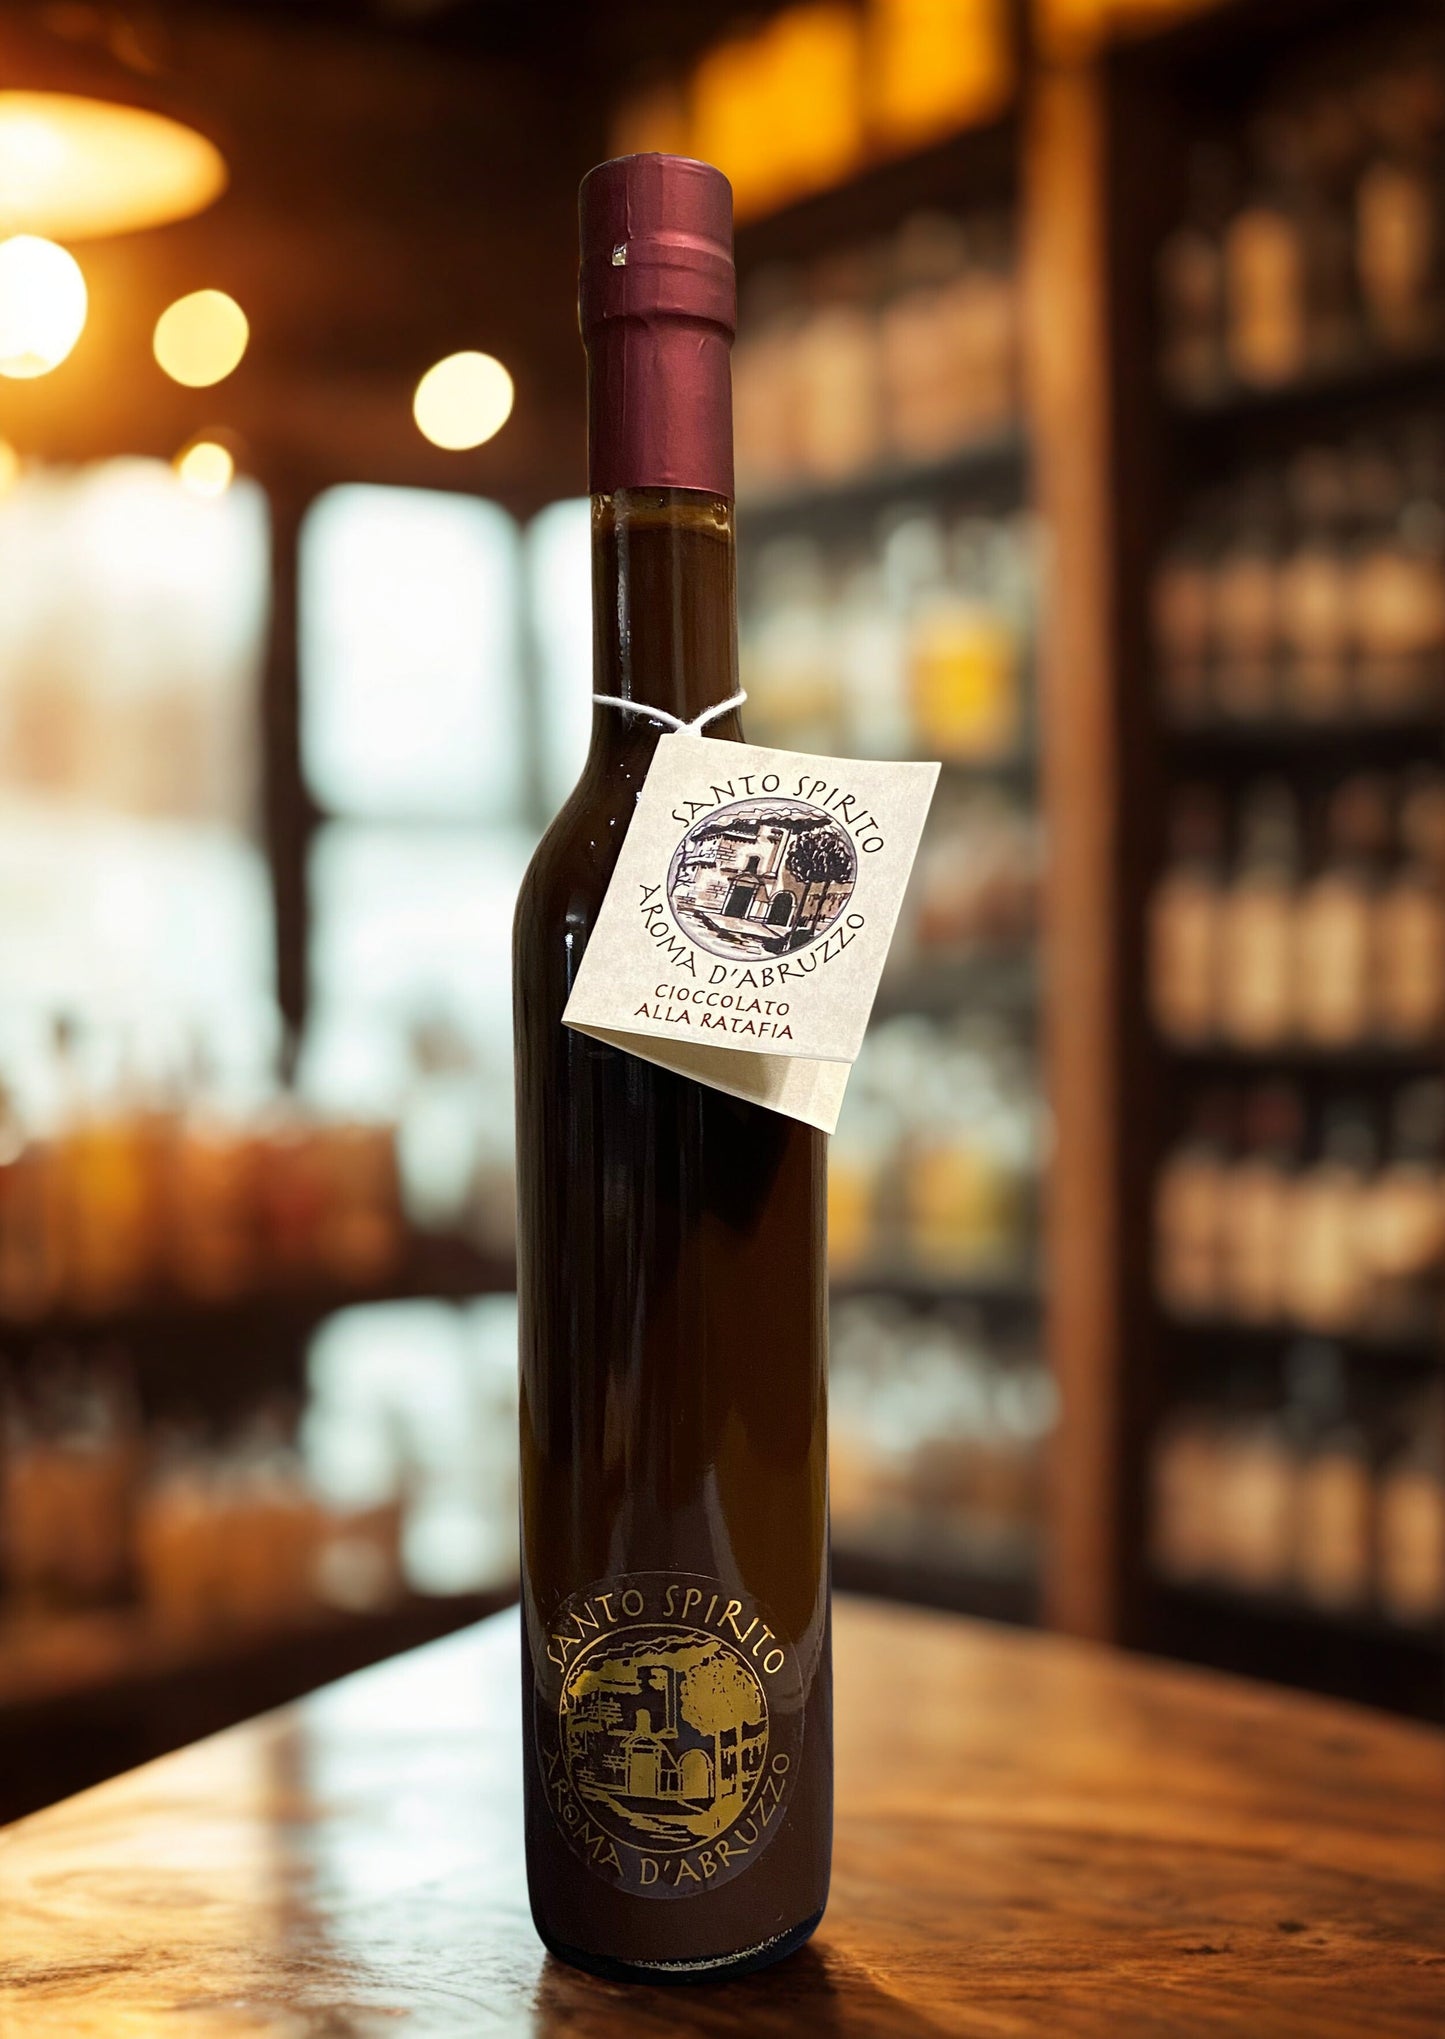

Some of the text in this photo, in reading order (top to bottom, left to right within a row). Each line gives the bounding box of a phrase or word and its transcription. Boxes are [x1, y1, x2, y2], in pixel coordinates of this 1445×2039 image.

[672, 773, 884, 855] SANTO SPIRITO
[638, 883, 865, 989] AROMA D'ABRUZZO
[634, 1002, 793, 1040] ALLA RATAFIA
[655, 983, 790, 1017] CIOCCOLATO
[547, 1584, 785, 1675] SANTO SPIRITO
[543, 1750, 791, 1887] AROMA D'ABRUZZO
